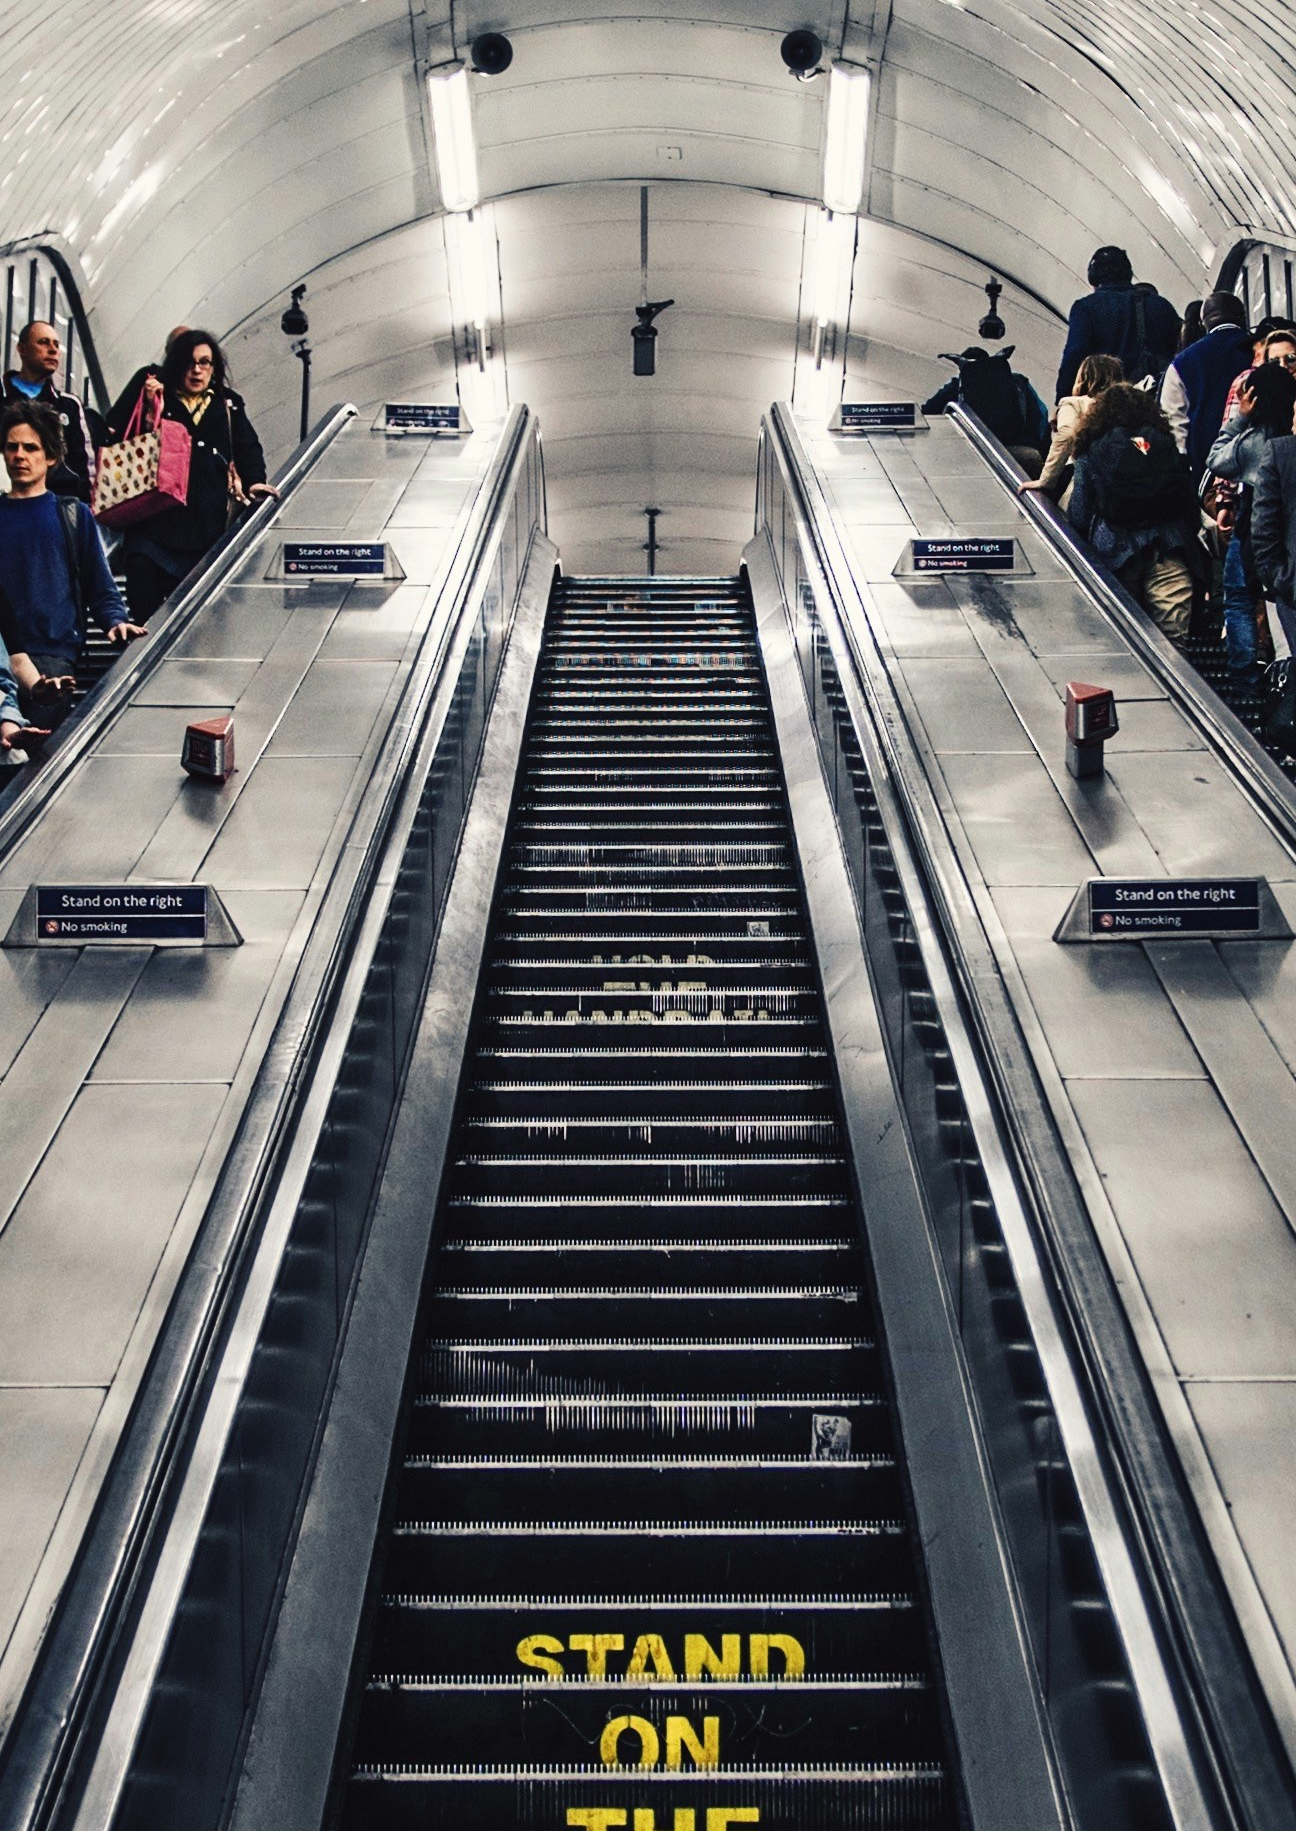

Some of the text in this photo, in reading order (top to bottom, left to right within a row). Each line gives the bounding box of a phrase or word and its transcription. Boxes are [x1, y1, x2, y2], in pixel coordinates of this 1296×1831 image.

[298, 547, 323, 556] Stand
[335, 548, 350, 556] the
[351, 548, 372, 558] right
[927, 543, 952, 553] Stand
[964, 544, 979, 552] the
[980, 543, 1000, 553] right
[310, 564, 339, 572] smoking
[61, 894, 183, 910] Stand on the right
[1115, 888, 1236, 903] Stand on the right
[61, 921, 128, 934] No smoking
[1115, 915, 1182, 927] No smoking
[516, 1633, 805, 1682] STAND
[599, 1715, 720, 1773] ON
